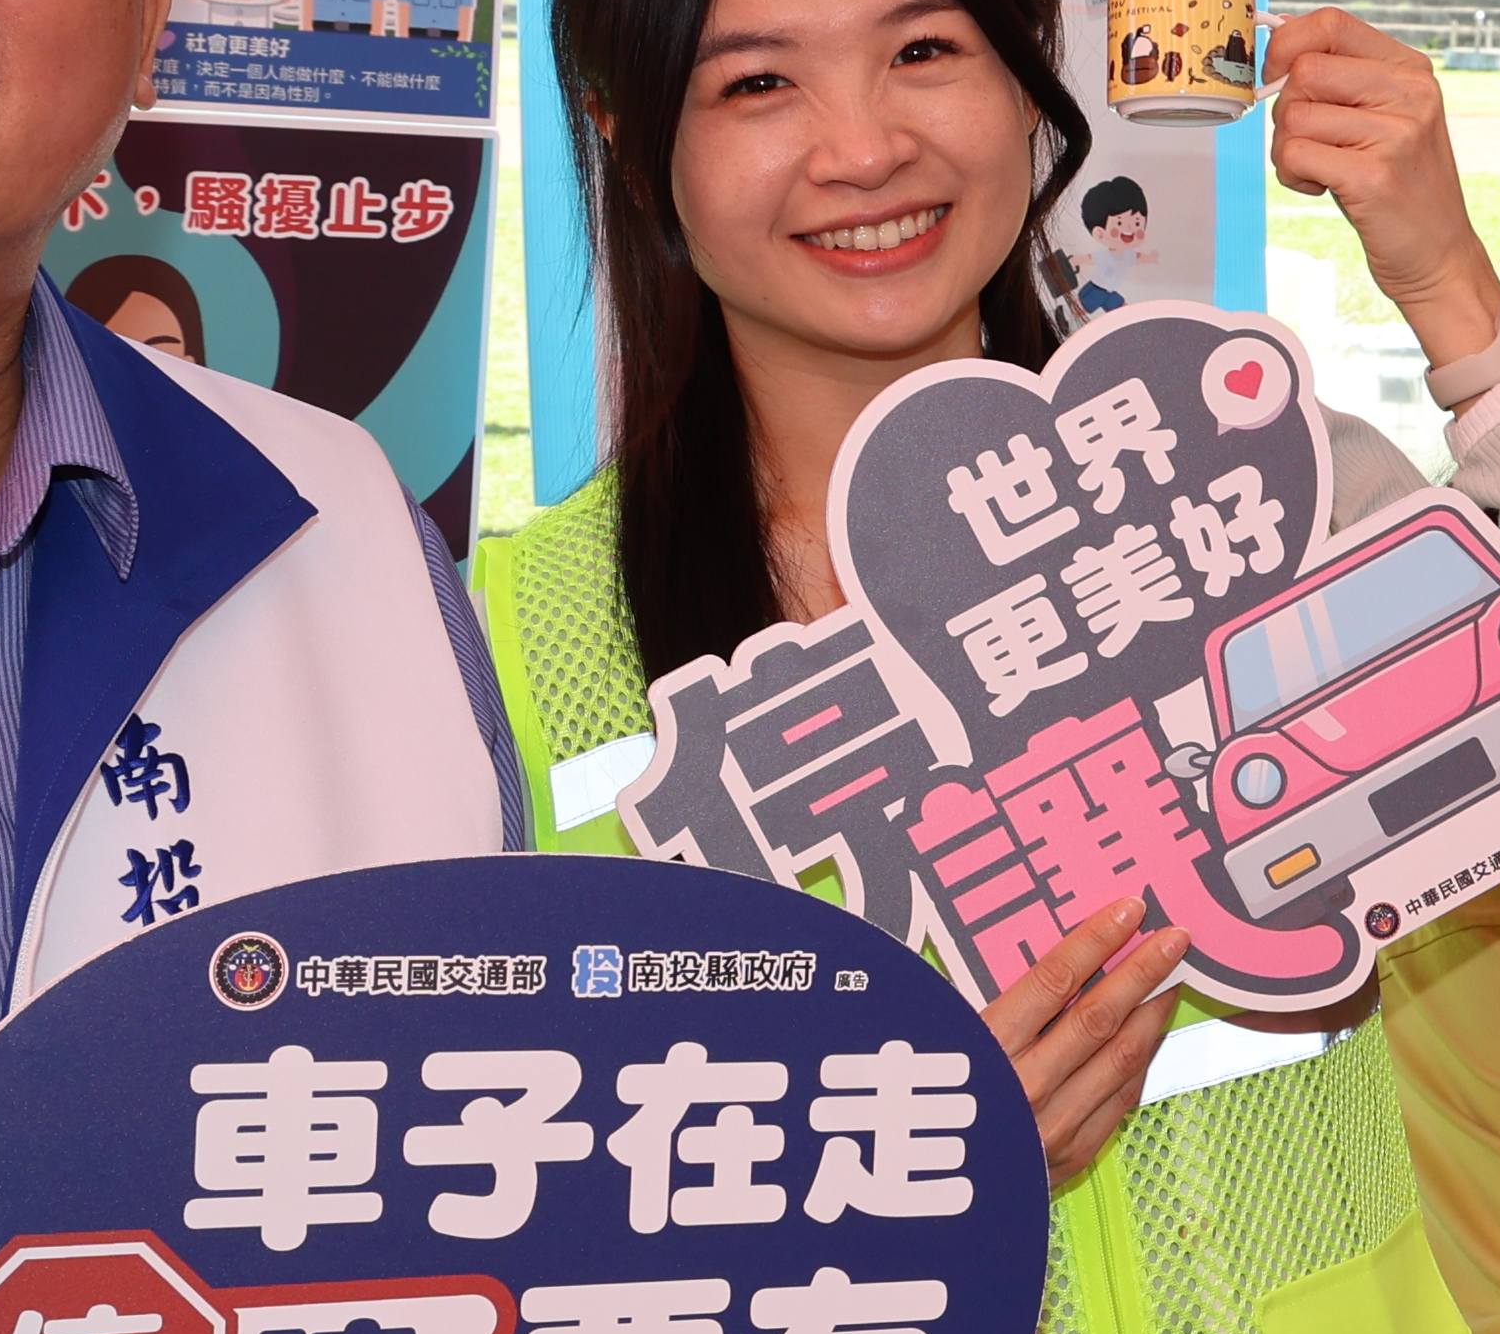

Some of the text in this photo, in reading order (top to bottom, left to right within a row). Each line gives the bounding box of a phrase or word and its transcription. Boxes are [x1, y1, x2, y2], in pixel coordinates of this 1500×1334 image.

[186, 33, 291, 58] 社會更美好
[947, 376, 1180, 568] 世界
[954, 463, 1287, 719] 更美好
[299, 956, 546, 995] 中華民國交通部
[631, 953, 815, 991] 南投縣政府
[836, 970, 868, 991] 廣告
[183, 1041, 978, 1250] 車子在走
